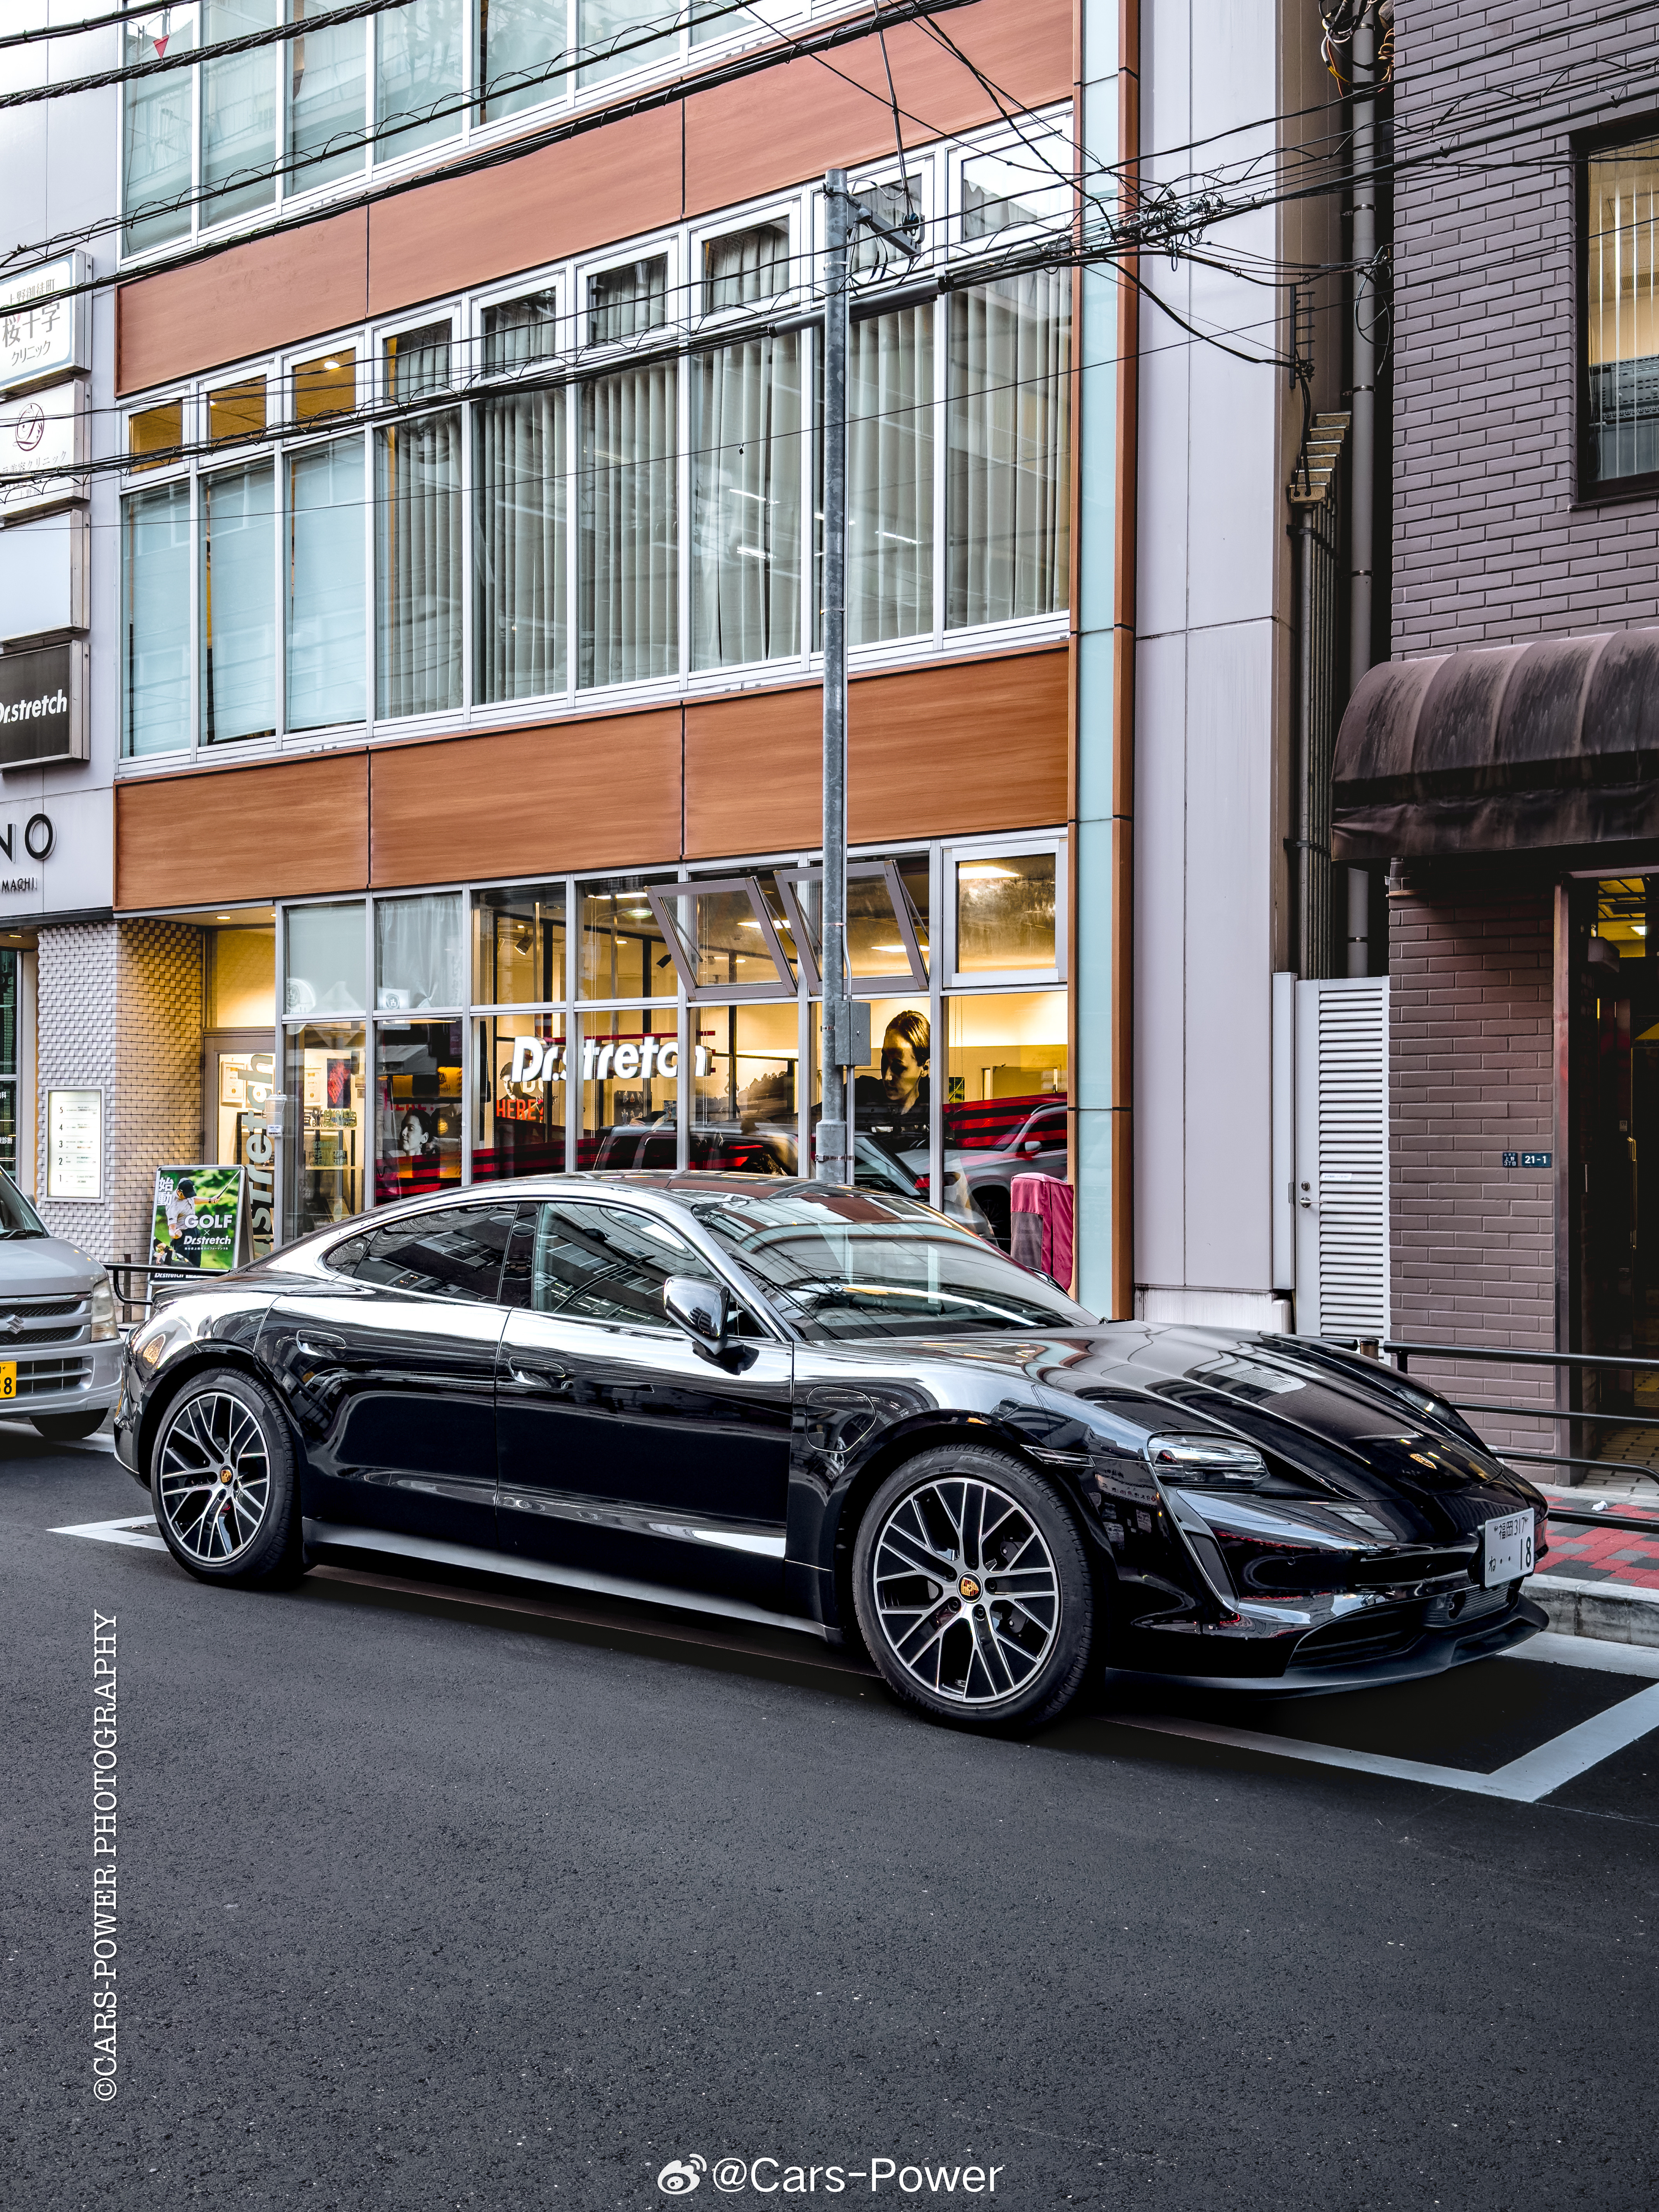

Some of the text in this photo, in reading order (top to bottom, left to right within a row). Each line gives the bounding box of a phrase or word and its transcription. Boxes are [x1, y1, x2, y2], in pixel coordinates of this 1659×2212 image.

[3, 302, 60, 348] 桜十字
[12, 340, 50, 366] クリニック
[0, 689, 67, 724] r.stretch
[1525, 1155, 1546, 1164] 21-1
[157, 1177, 174, 1206] 始動
[184, 1214, 232, 1228] GOLF
[183, 1235, 231, 1245] Dr.stretch
[1499, 1516, 1525, 1540] 福岡 317
[1488, 1556, 1496, 1572] ね
